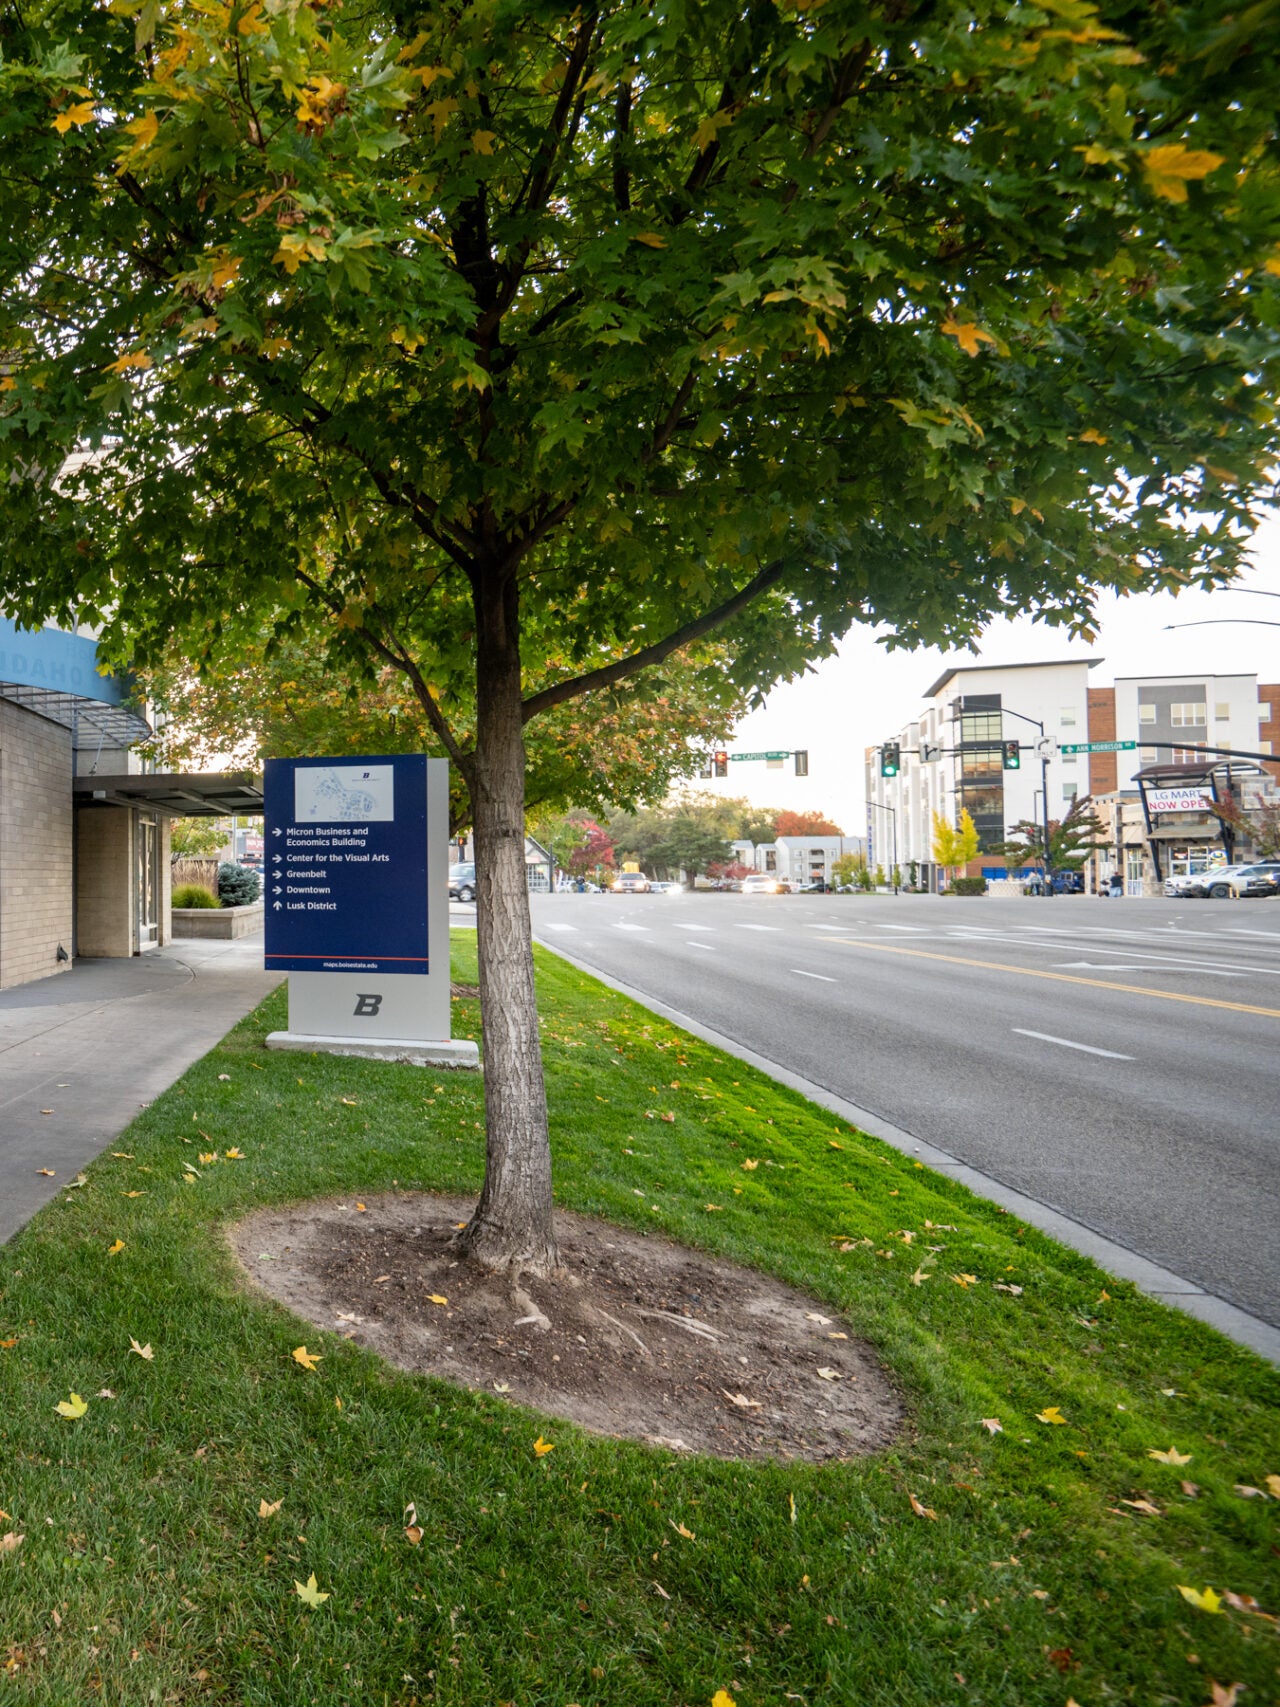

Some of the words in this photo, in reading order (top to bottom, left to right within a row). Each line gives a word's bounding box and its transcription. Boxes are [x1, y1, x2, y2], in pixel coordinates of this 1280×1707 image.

[0, 650, 82, 686] IDAHO
[1091, 742, 1123, 751] MORRISON
[742, 752, 768, 761] CAPITOL
[1155, 791, 1168, 800] LG
[1171, 789, 1202, 799] MART
[1149, 801, 1177, 810] NOW
[286, 828, 314, 836] Micron
[316, 828, 351, 836] Business
[353, 827, 369, 836] and
[286, 838, 330, 846] Economics
[332, 838, 366, 848] Building
[286, 854, 314, 862] Center
[315, 853, 327, 862] for
[329, 853, 343, 862] the
[345, 853, 370, 862] Visual
[372, 853, 390, 862] Arts
[286, 869, 327, 878] Greenbelt
[286, 885, 331, 894] Downtown
[286, 902, 306, 910] Lusk
[307, 902, 337, 910] District
[353, 993, 383, 1017] B
